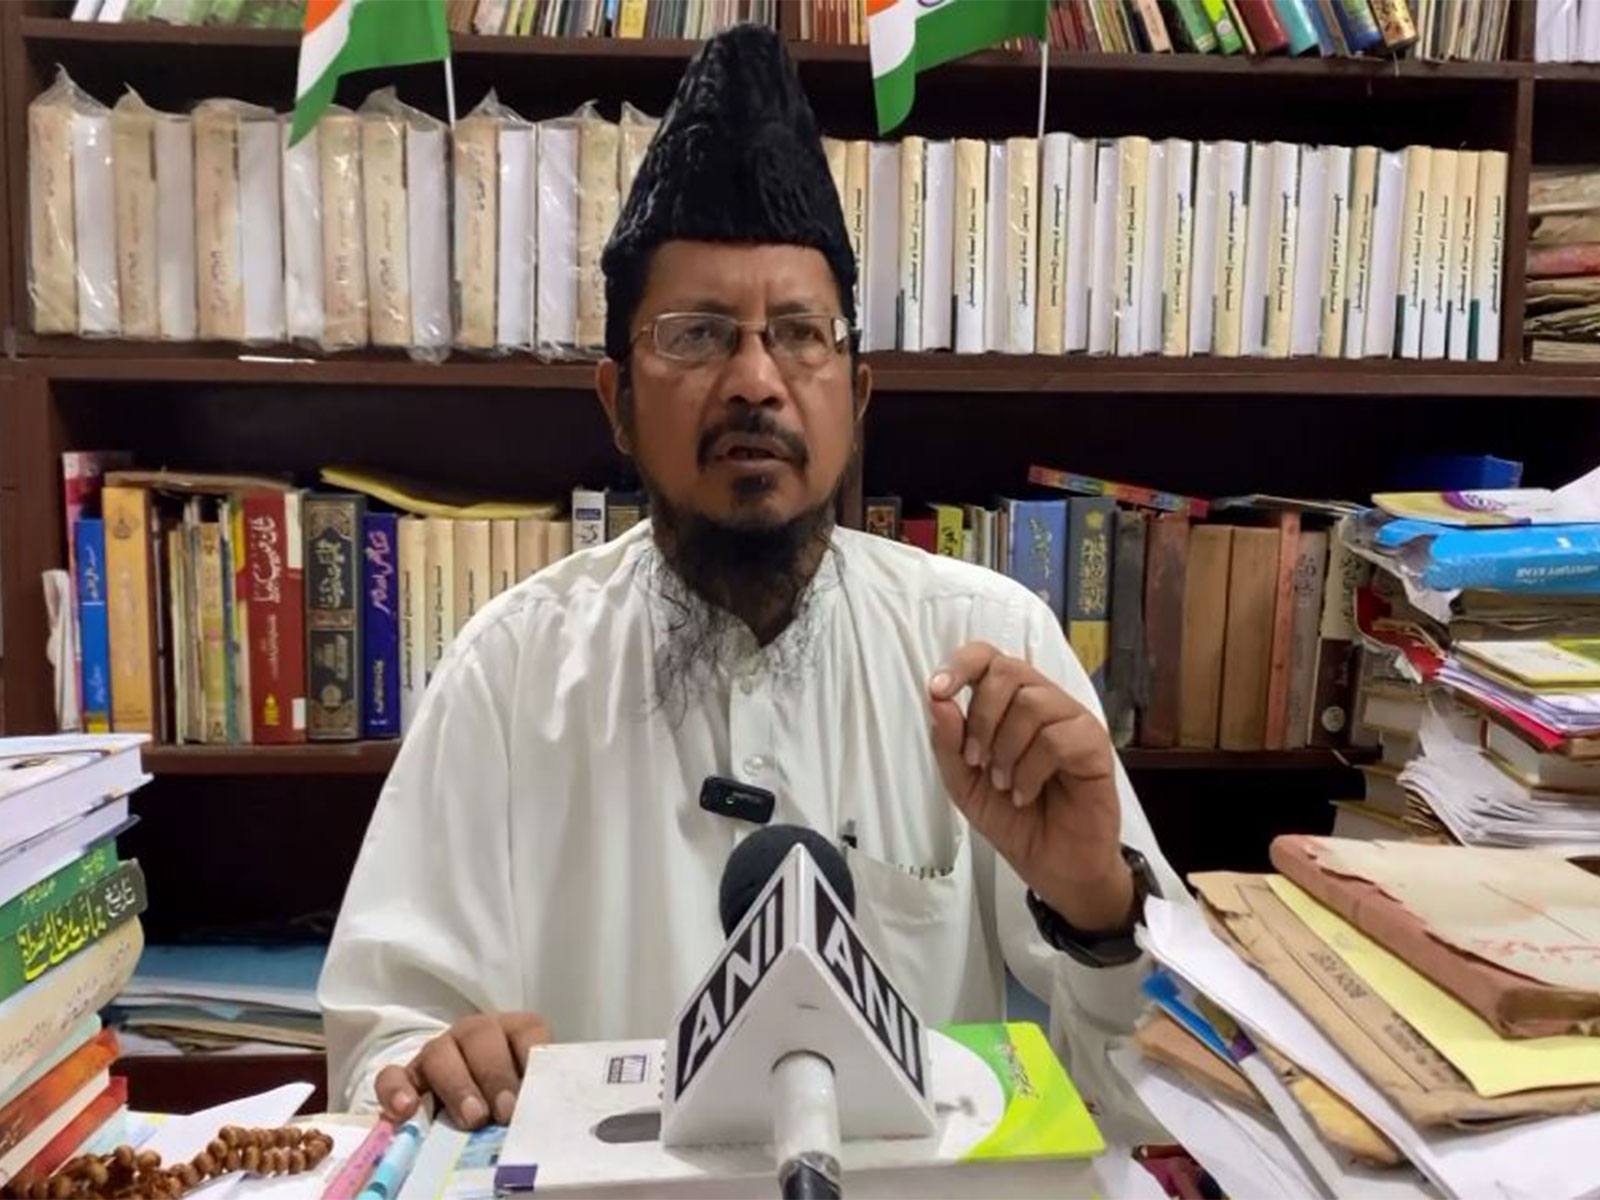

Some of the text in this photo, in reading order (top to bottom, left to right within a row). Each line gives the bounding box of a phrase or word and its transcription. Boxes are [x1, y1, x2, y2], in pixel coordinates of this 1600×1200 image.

[105, 878, 136, 918] تاریخ
[682, 892, 777, 1086] ANI
[822, 913, 918, 1085] ANI
